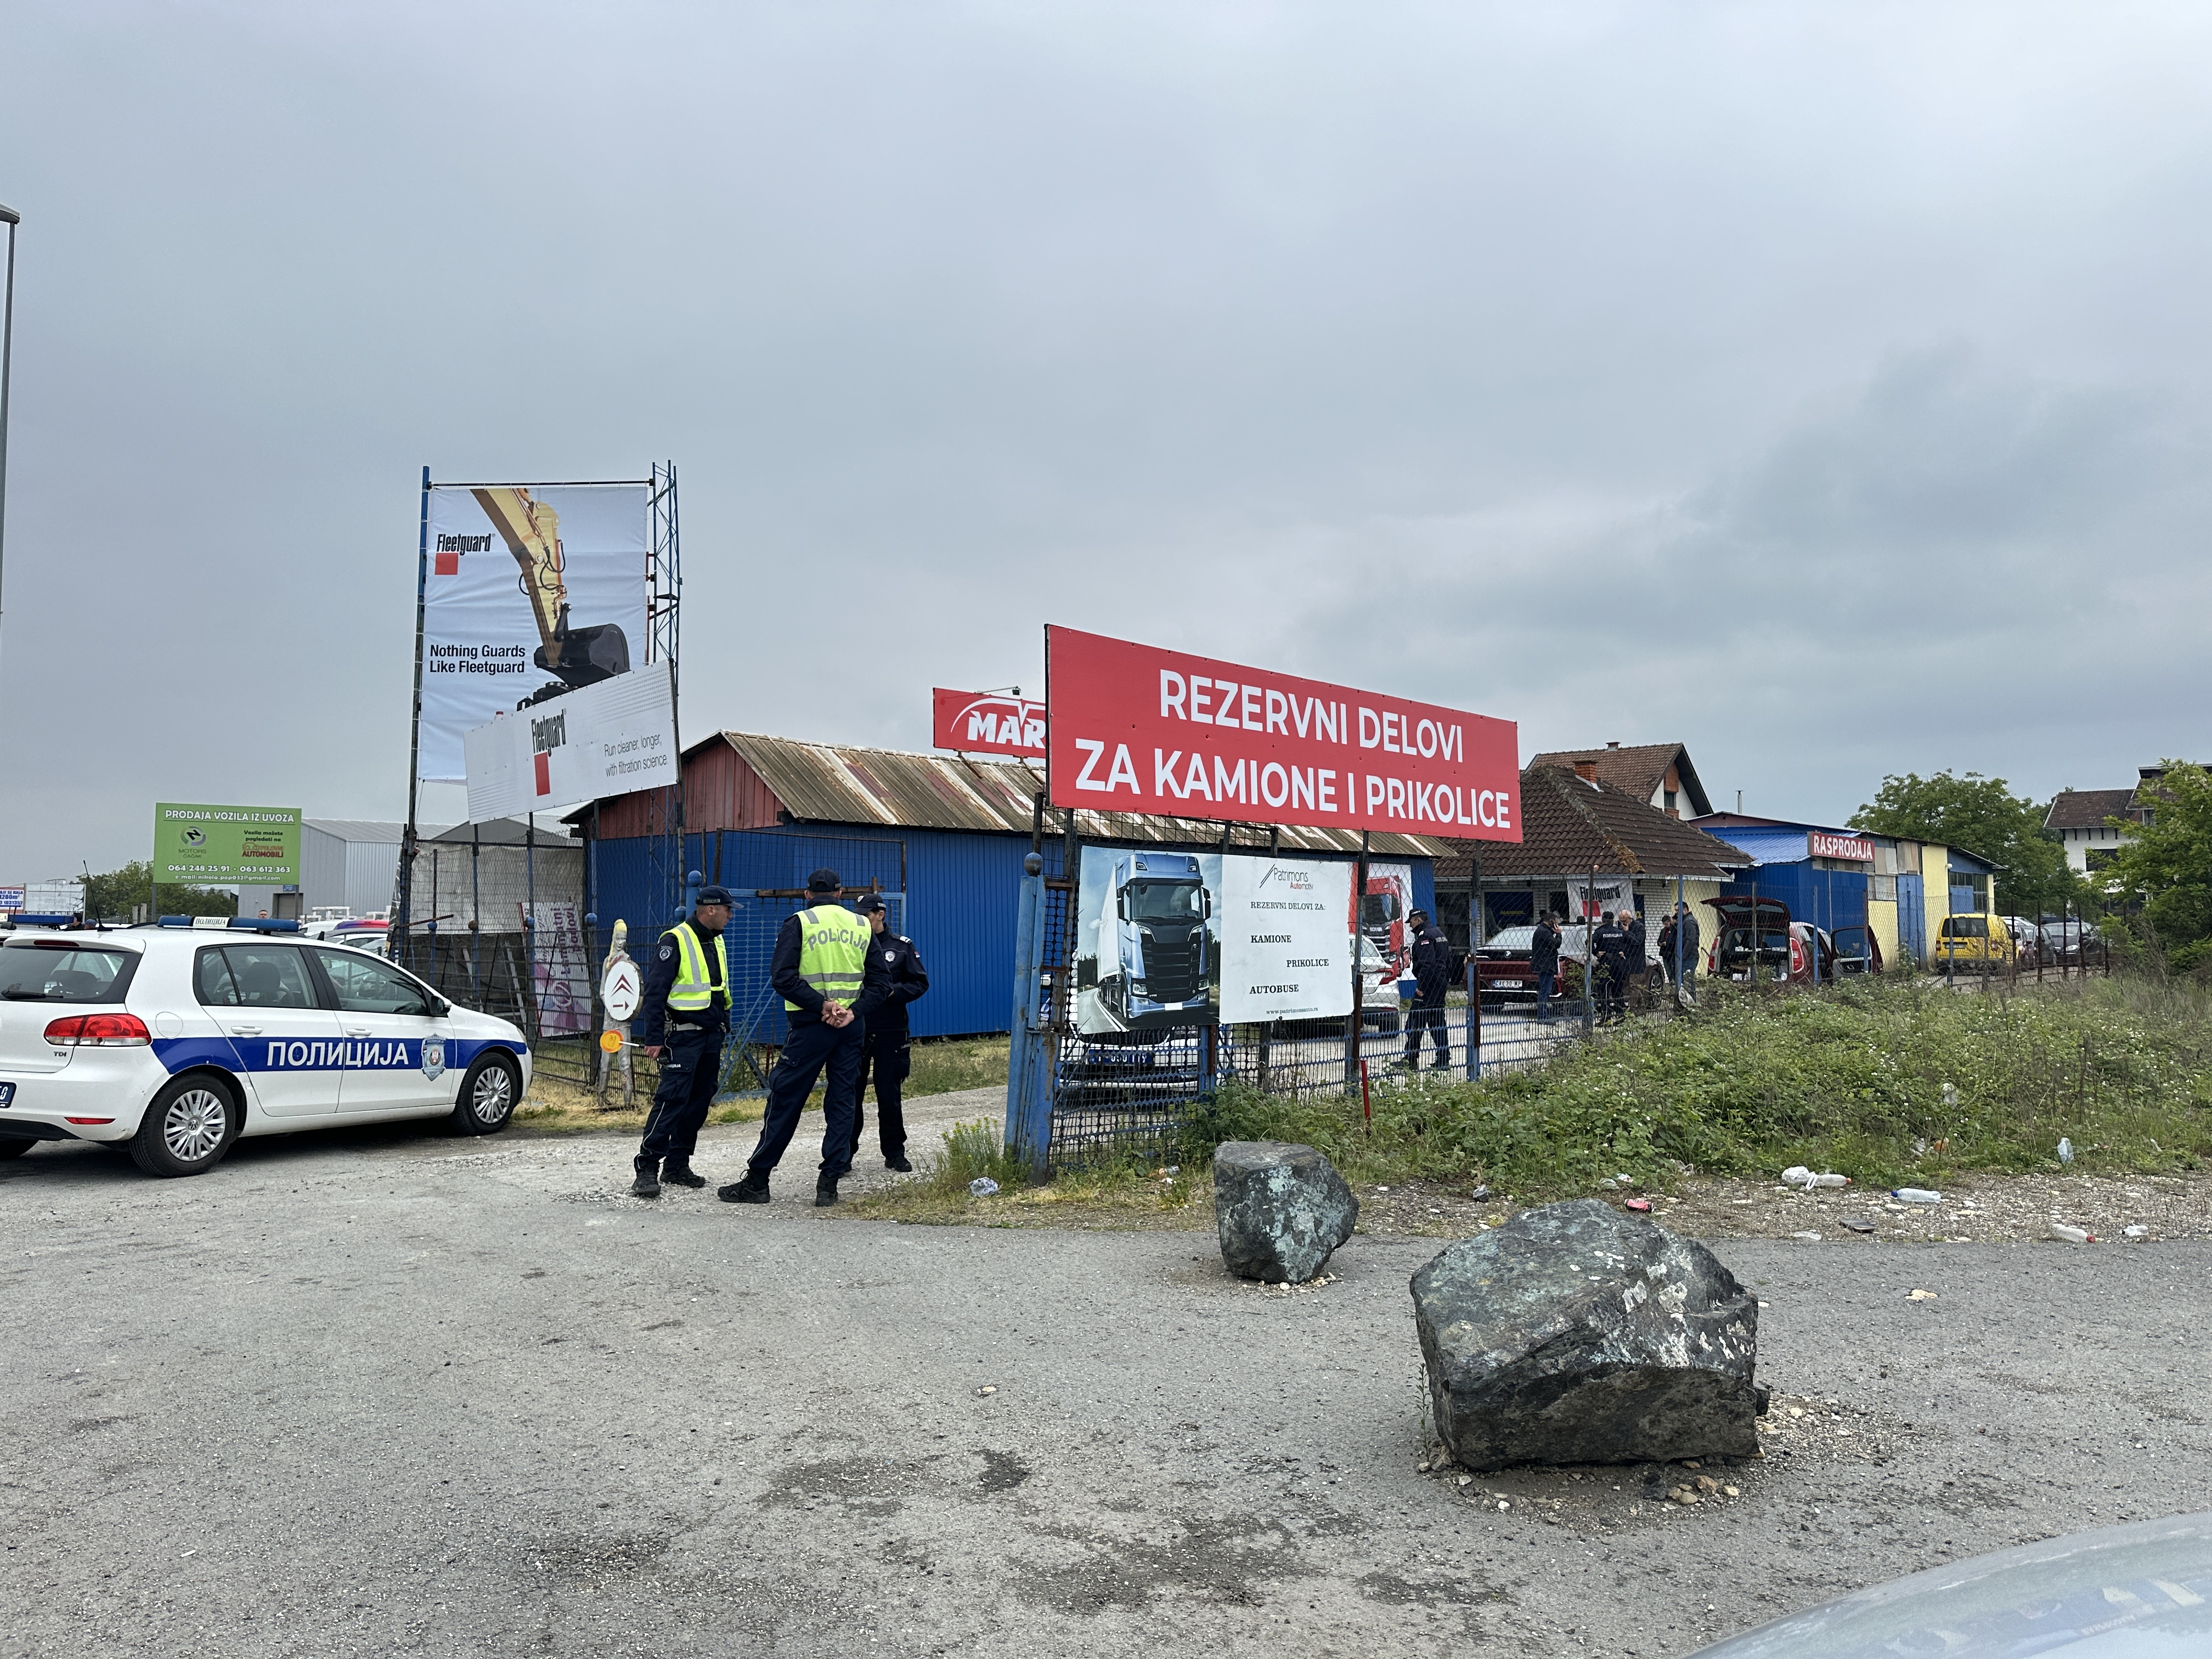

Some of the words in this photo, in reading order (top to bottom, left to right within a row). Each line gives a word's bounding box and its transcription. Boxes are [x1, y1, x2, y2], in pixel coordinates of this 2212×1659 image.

[437, 534, 491, 556] Fleetguard
[430, 645, 477, 659] Nothing
[482, 645, 526, 657] Guards
[430, 661, 455, 673] Like
[459, 661, 524, 676] Fleetguard
[1160, 669, 1347, 746] REZERVNI
[1358, 706, 1463, 763] DELOVI
[531, 708, 566, 757] Fleetguard
[604, 744, 616, 757] Run
[617, 739, 640, 752] cleaner,
[641, 733, 662, 751] longer,
[605, 763, 618, 777] with
[618, 759, 641, 776] filtration
[1075, 738, 1141, 795] ZA
[1154, 747, 1338, 814] KAMIONE
[1348, 772, 1356, 815] I
[1366, 775, 1511, 830] PRIKOLICE
[165, 810, 212, 820] PRODAJA
[214, 811, 249, 821] VOZILA
[251, 813, 259, 822] IZ
[262, 813, 295, 823] UVOZA
[1814, 835, 1873, 860] RASPRODAJA
[1274, 867, 1308, 882] Patrimons
[1290, 882, 1314, 890] Automotiv
[1250, 901, 1286, 910] REZERVNI
[195, 917, 226, 926] ПОЛИЦИЈА
[808, 928, 868, 953] POLICIJA
[1251, 935, 1292, 943] KAMIONE
[1286, 959, 1329, 968] PRIKOLICE
[1249, 984, 1299, 994] AUTOBUSE
[267, 1041, 409, 1068] ПОЛИЦИЈА
